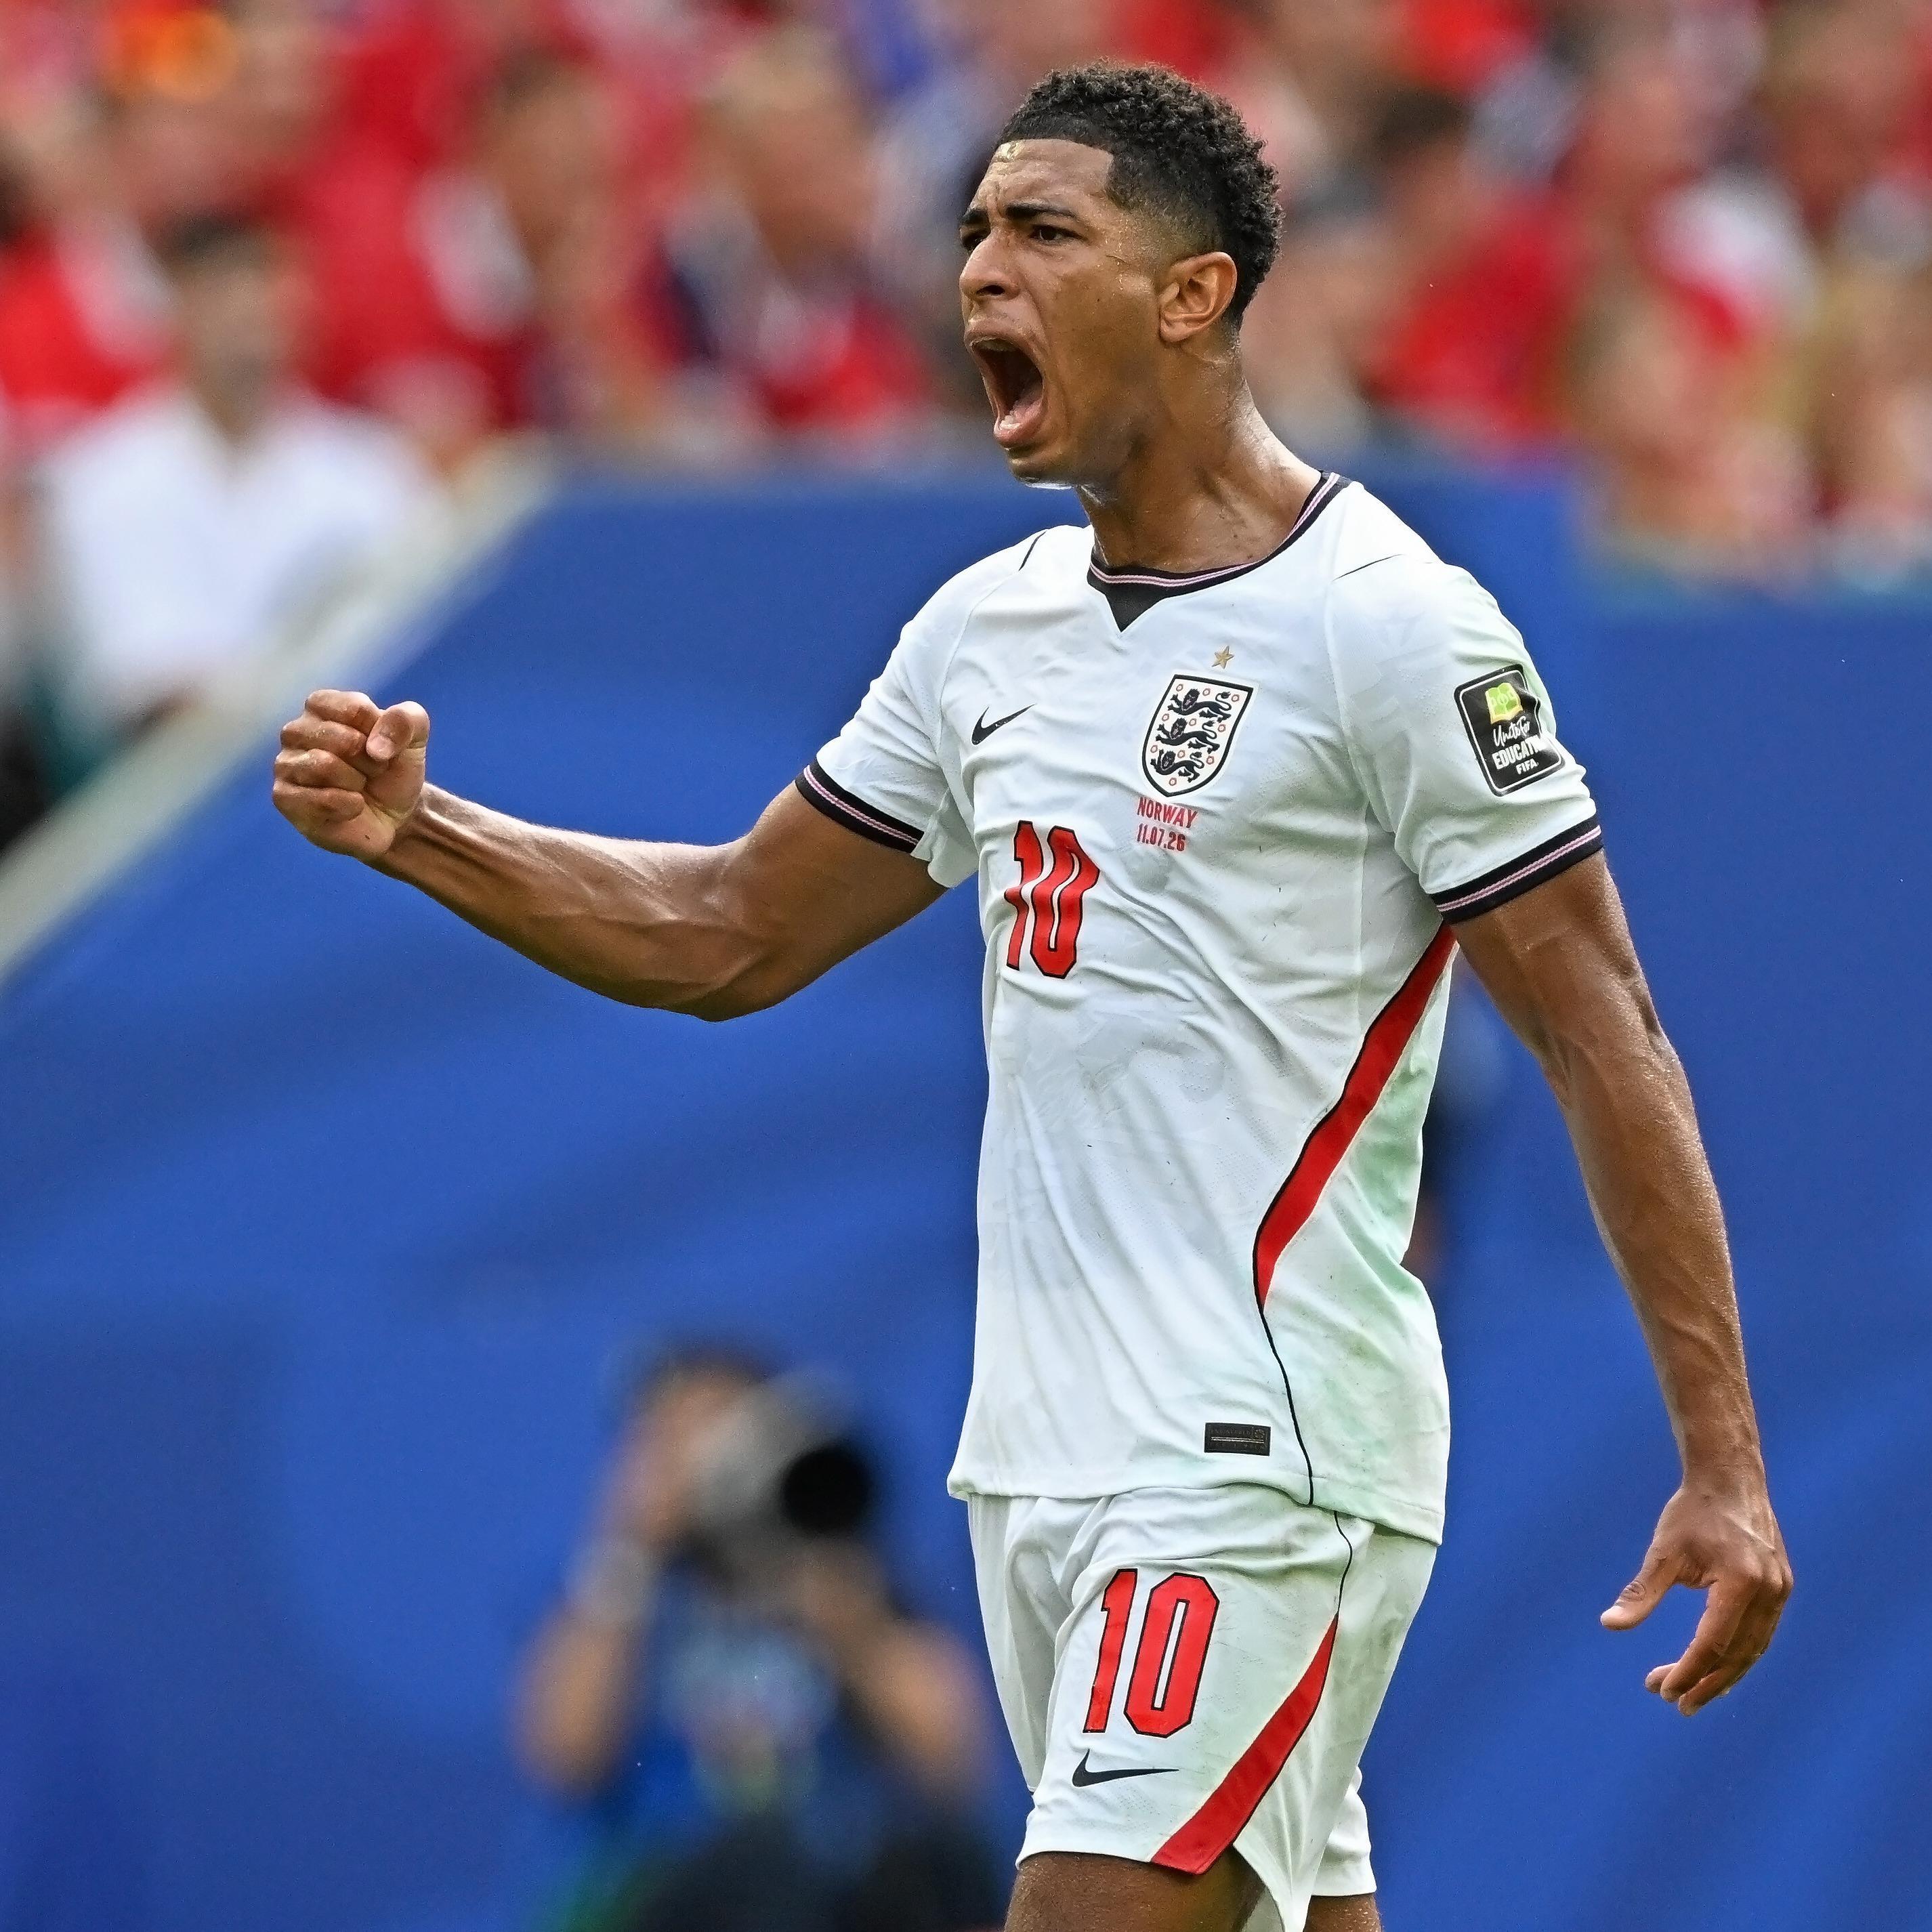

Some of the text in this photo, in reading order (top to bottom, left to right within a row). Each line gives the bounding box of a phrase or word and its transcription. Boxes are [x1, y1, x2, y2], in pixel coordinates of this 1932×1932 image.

[1515, 758, 1537, 774] FIFA
[1137, 797, 1198, 828] NORWAY
[1137, 823, 1185, 852] 11.07.26
[1004, 820, 1100, 979] 10
[1083, 1568, 1220, 1738] 10
